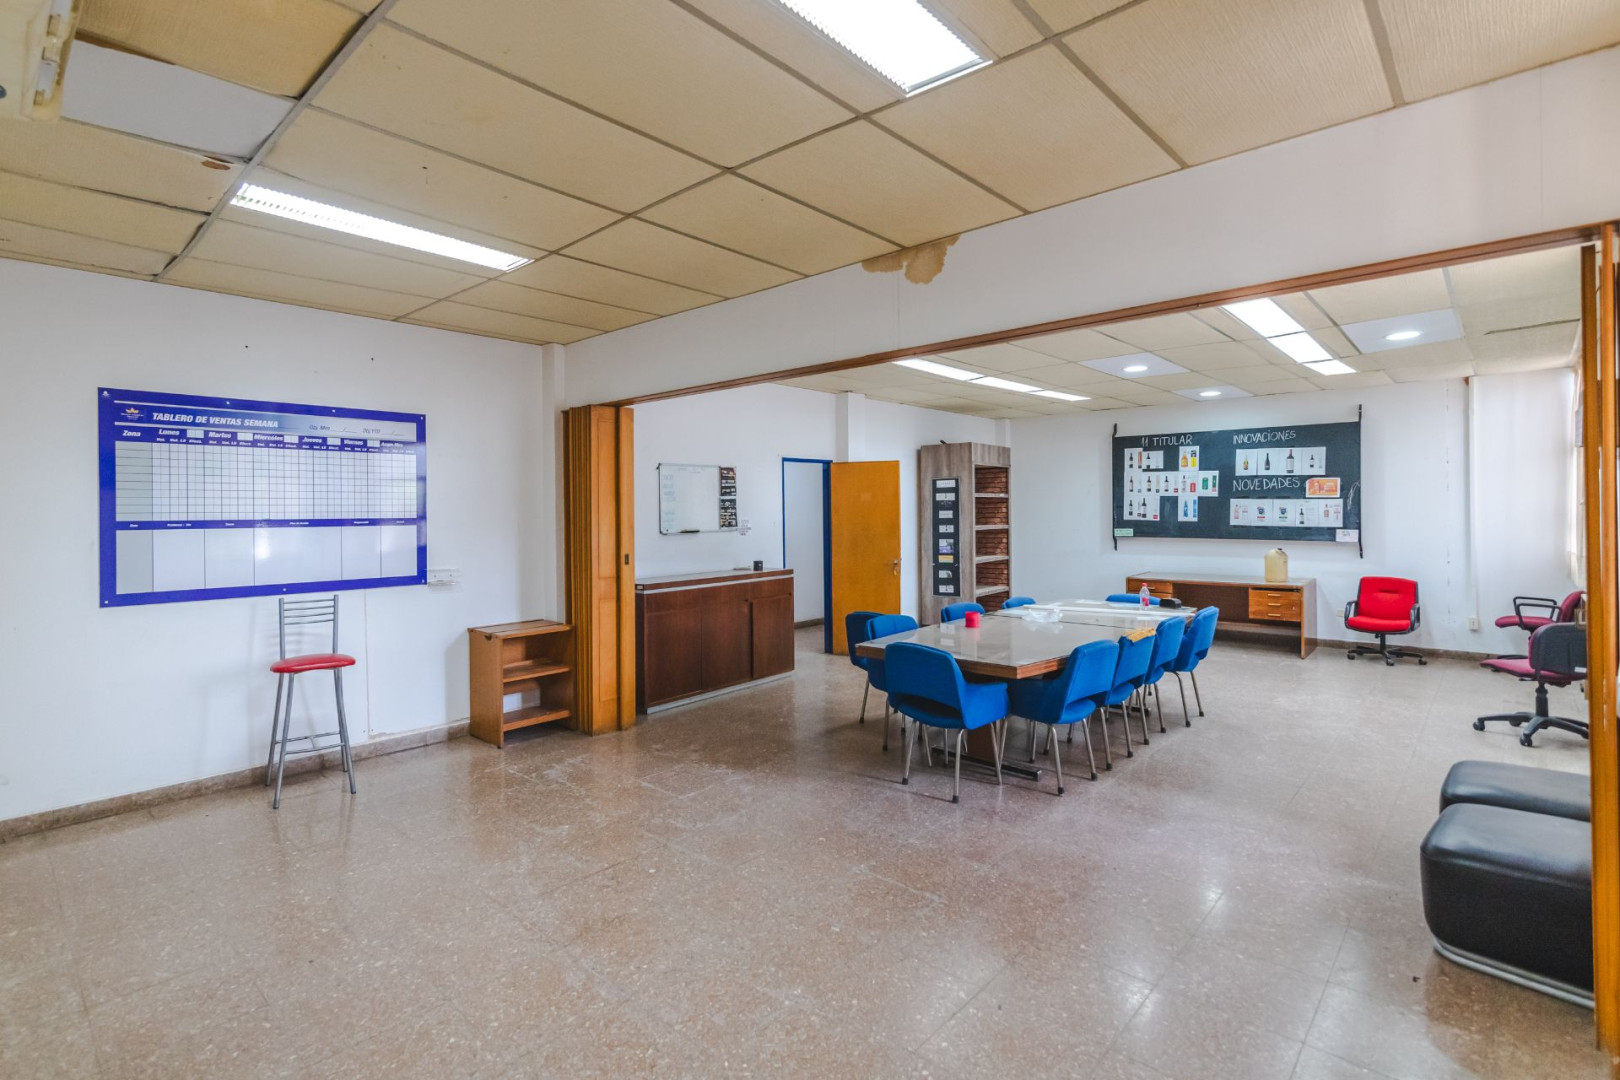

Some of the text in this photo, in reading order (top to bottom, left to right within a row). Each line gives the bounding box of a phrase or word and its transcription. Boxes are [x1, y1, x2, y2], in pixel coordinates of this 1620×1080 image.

[152, 412, 194, 423] TABLERO
[195, 415, 207, 424] DE
[209, 416, 242, 426] VENTAS
[243, 419, 279, 428] SEMANA
[122, 429, 141, 437] Zona
[158, 428, 180, 436] Lunes
[208, 431, 232, 439] Martes
[1152, 434, 1193, 446] TITULAR
[1232, 477, 1300, 492] NOVEDADES
